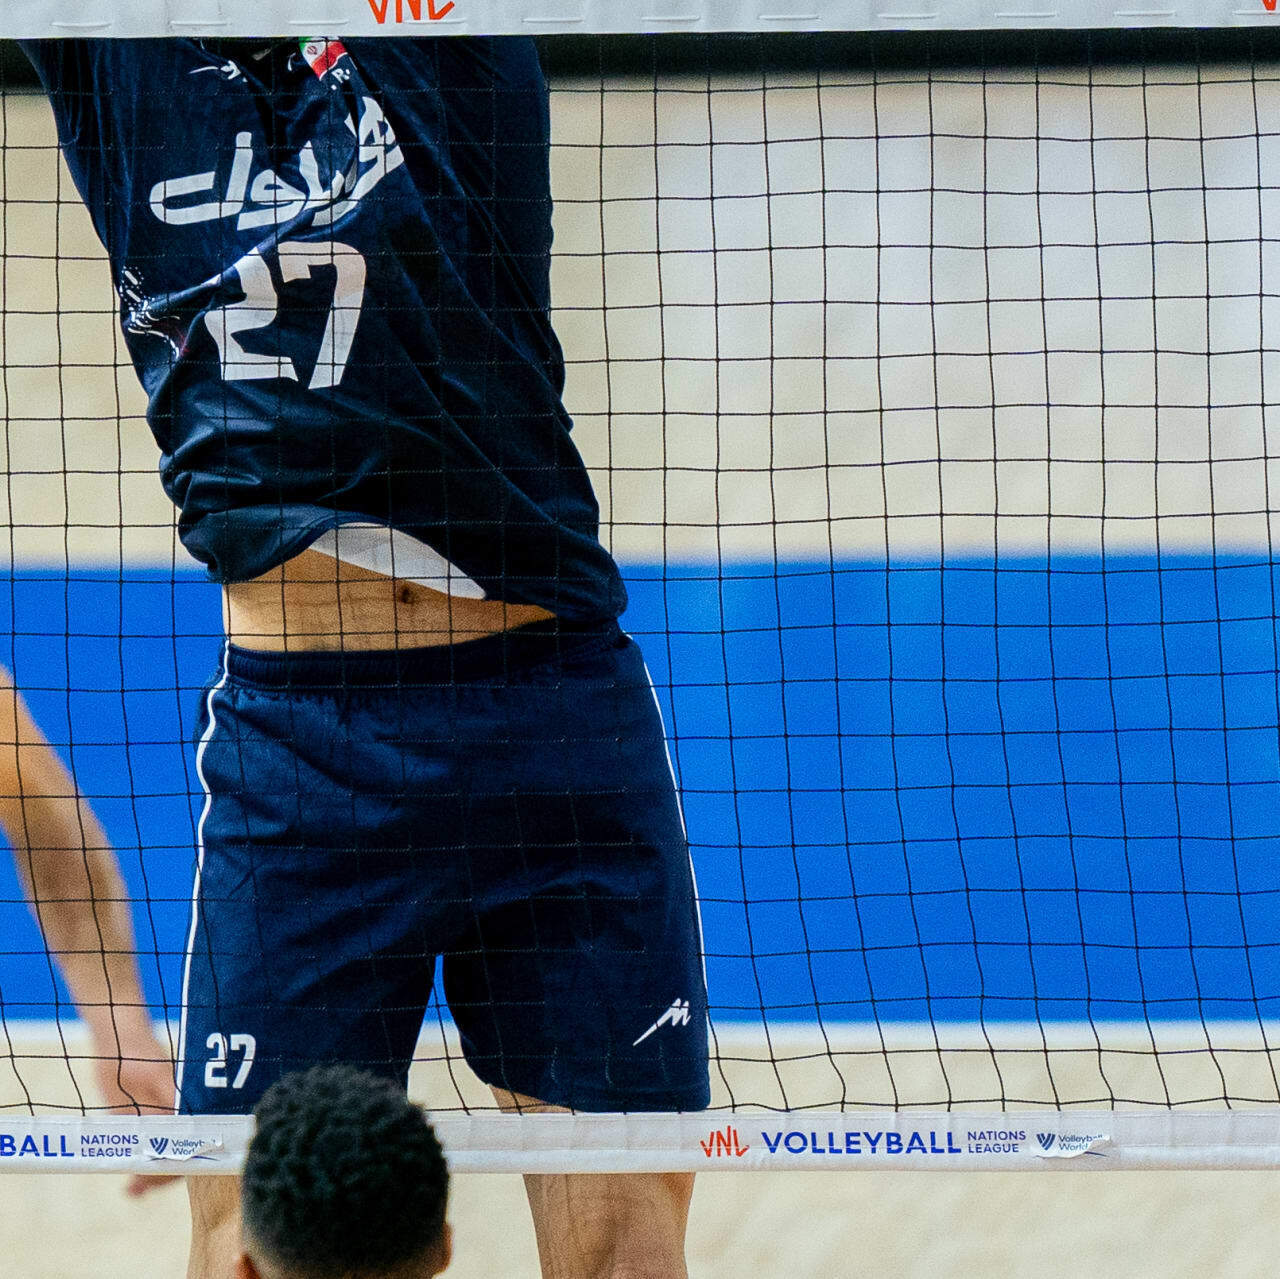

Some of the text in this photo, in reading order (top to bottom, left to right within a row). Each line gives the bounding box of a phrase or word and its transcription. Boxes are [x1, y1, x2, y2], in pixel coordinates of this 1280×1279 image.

[204, 241, 366, 389] 27
[204, 1032, 256, 1089] 27
[80, 1134, 139, 1146] NATIONS
[700, 1125, 962, 1157] VNL VOLLEYBALL
[967, 1131, 1026, 1141] NATIONS
[81, 1147, 132, 1157] LEAGUE
[967, 1143, 1019, 1153] LEAGUE
